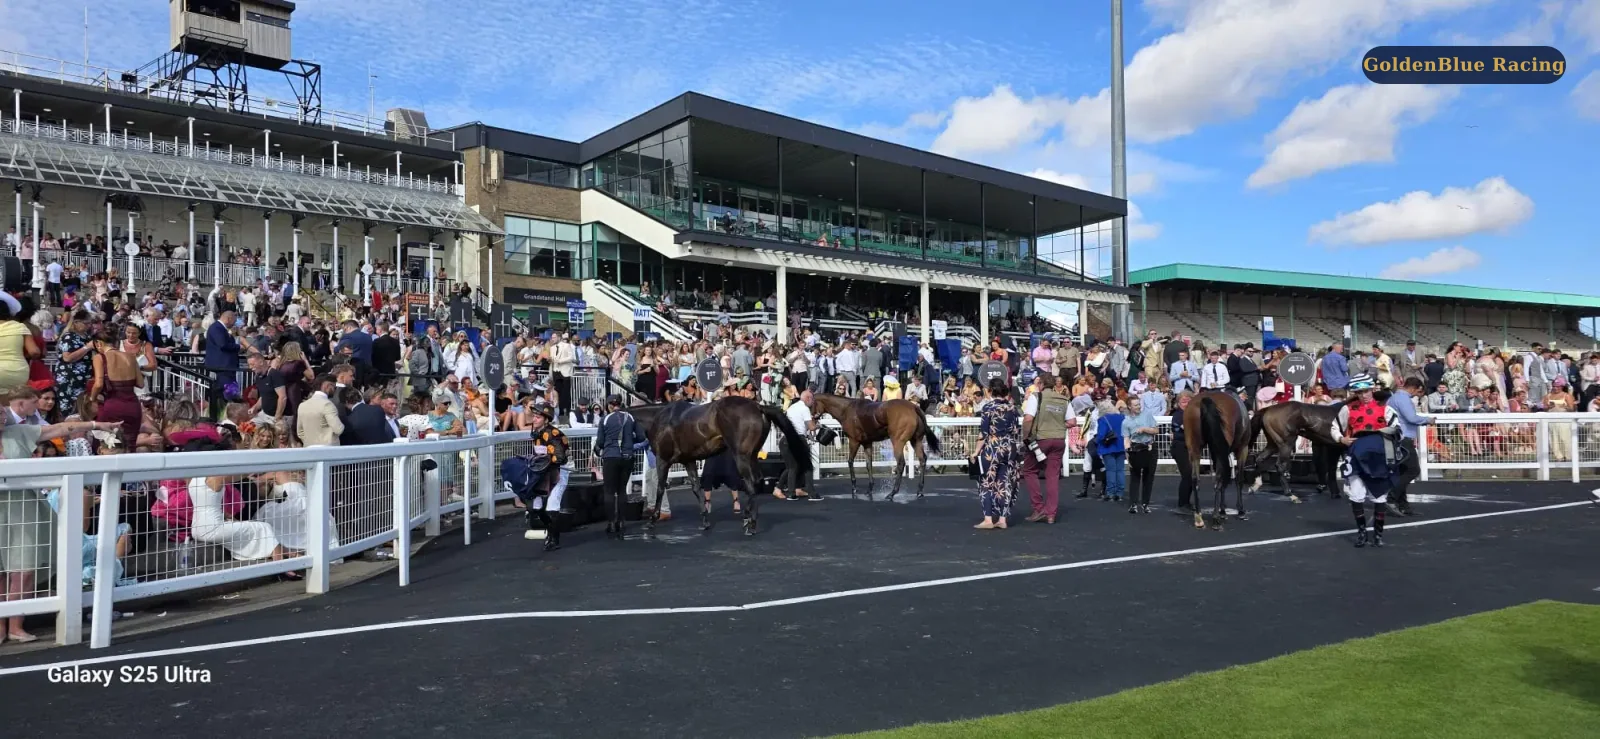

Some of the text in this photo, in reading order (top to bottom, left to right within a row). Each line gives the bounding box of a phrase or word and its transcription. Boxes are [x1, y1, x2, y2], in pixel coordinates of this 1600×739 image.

[523, 293, 554, 301] Grandstand
[634, 308, 651, 317] MATT
[489, 363, 500, 374] 2ND
[1287, 364, 1306, 374] 4TH
[706, 371, 716, 380] 1ST
[987, 371, 1002, 380] 3RD
